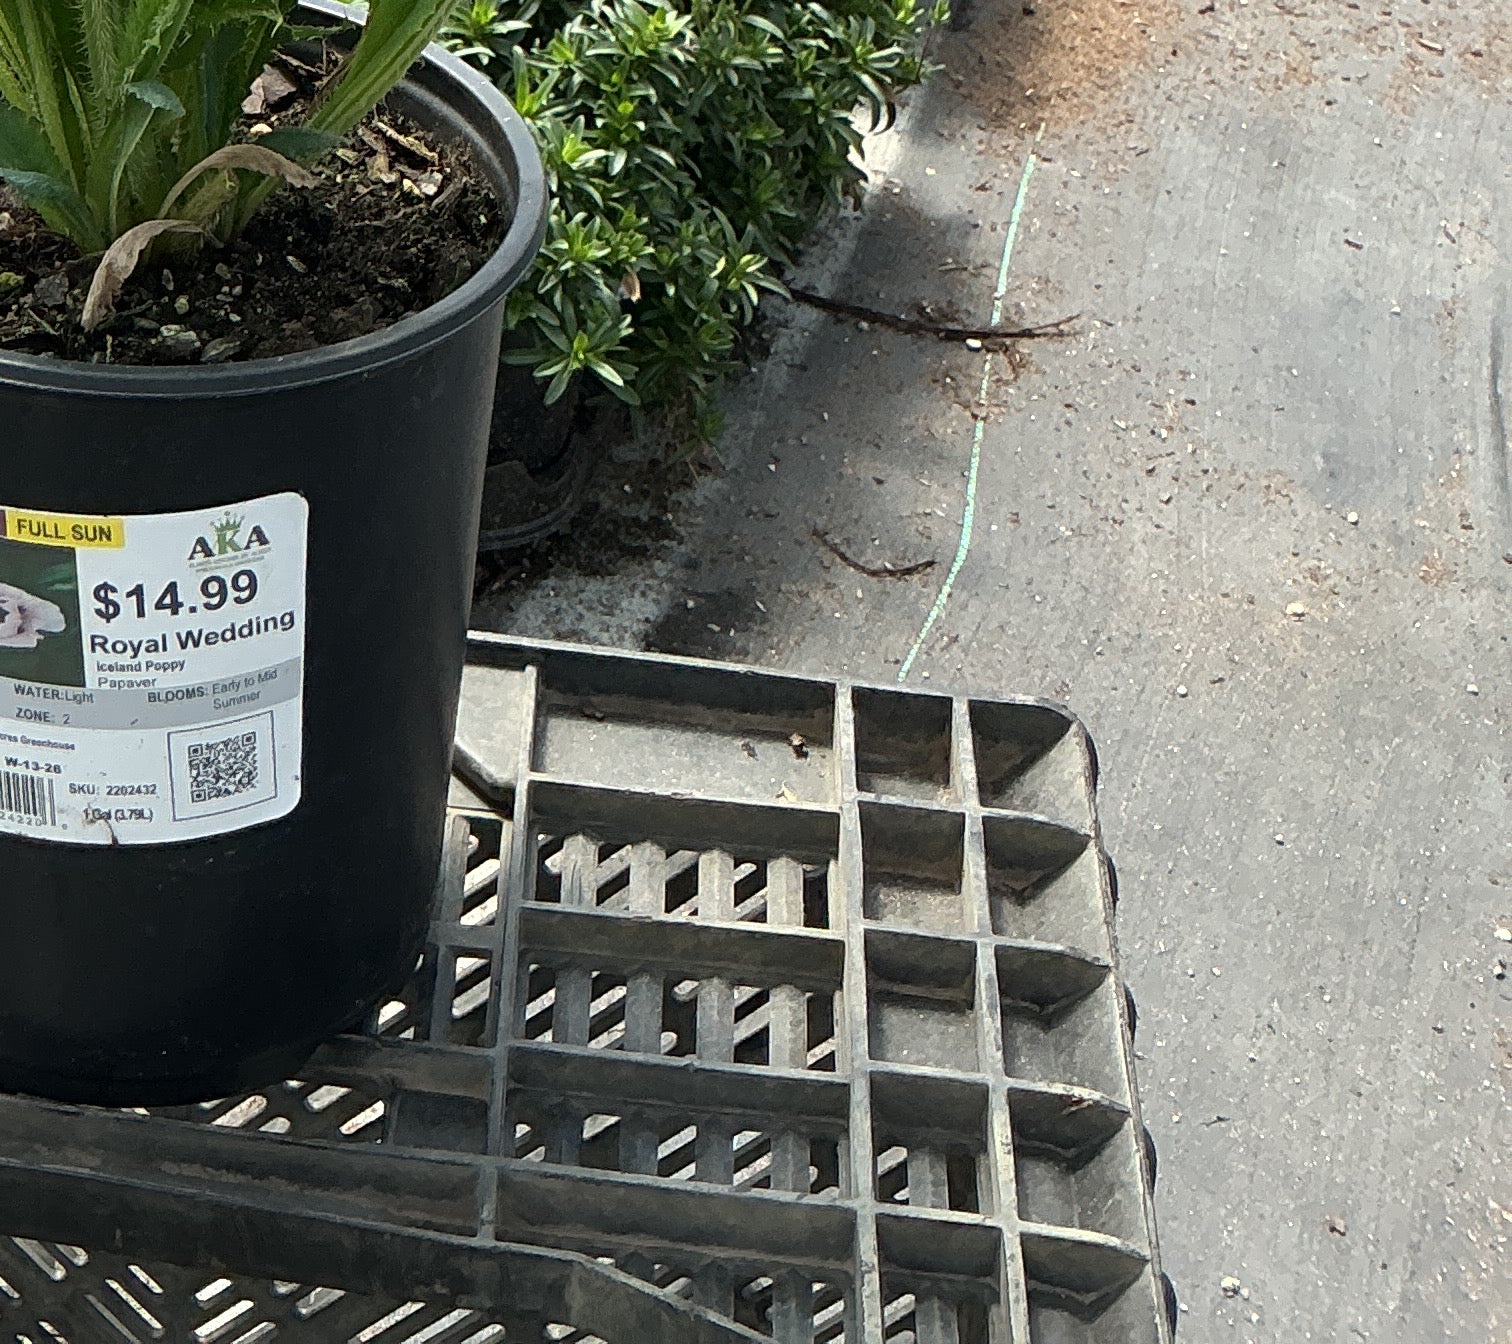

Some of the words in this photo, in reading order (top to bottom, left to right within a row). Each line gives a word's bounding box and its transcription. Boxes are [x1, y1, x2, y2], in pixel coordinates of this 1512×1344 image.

[16, 518, 66, 540] FULL
[71, 524, 113, 542] SUN
[187, 524, 271, 561] AKA
[92, 569, 259, 623] $14.99
[89, 633, 168, 659] Royal
[176, 610, 296, 650] Wedding
[96, 660, 143, 672] Iceland
[145, 659, 185, 672] Poppy
[97, 676, 157, 691] Papaver
[147, 686, 209, 703] BLOOMS:
[212, 681, 241, 696] Early
[244, 676, 255, 687] to
[257, 668, 278, 683] Mid
[213, 688, 261, 710] Summer
[15, 707, 56, 724] ZONE:
[62, 713, 71, 725] 2
[20, 734, 75, 751] Greenhouse
[68, 782, 100, 795] SKU:
[106, 783, 157, 797] 2202432
